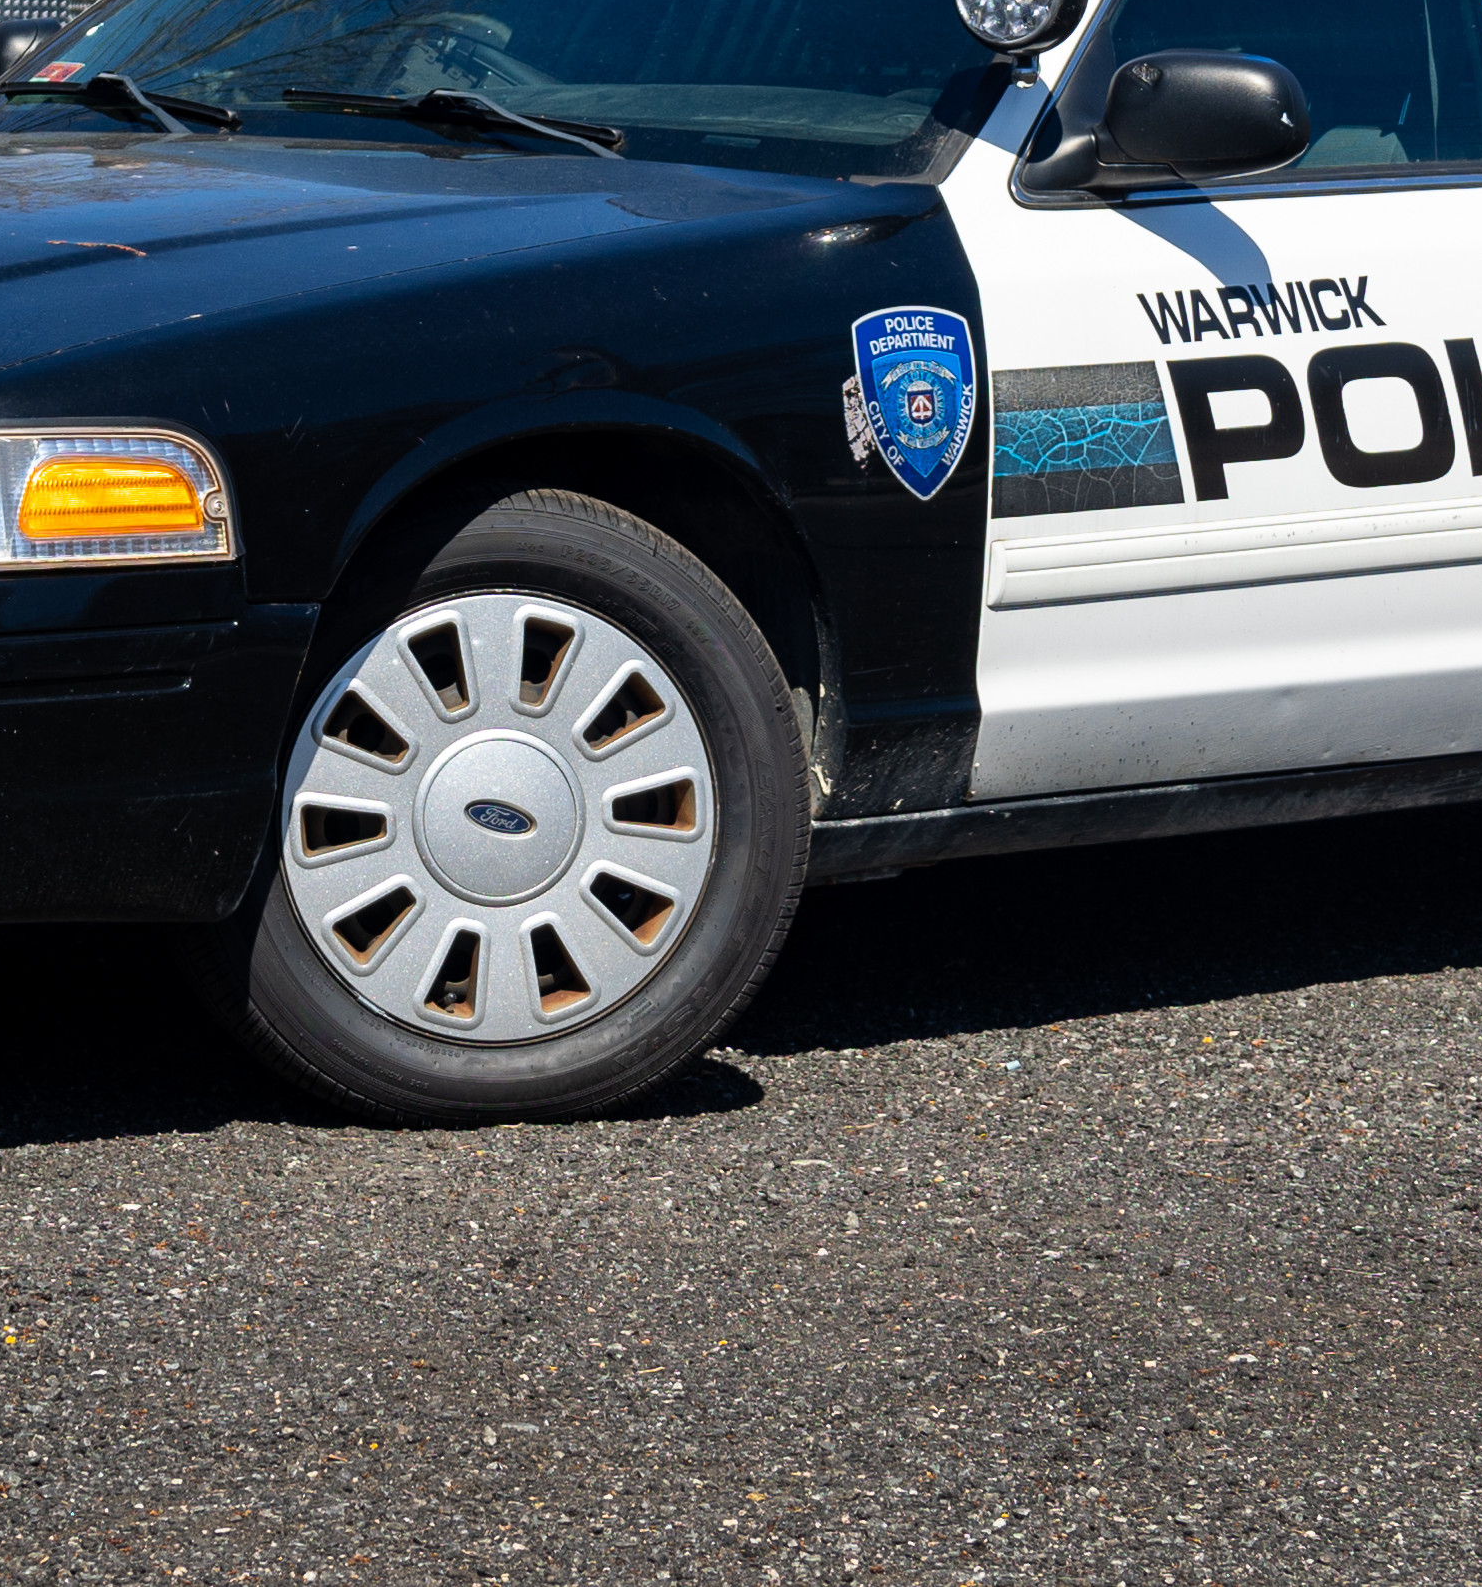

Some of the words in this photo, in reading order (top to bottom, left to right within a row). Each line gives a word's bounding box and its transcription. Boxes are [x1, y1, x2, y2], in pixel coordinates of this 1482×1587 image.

[1136, 275, 1389, 346] WARWICK
[884, 315, 935, 334] POLICE
[869, 332, 956, 356] DEPARTMENT
[868, 400, 890, 441] CITY
[887, 444, 906, 467] OF
[941, 383, 974, 467] WARWICK
[479, 807, 518, 830] Ford
